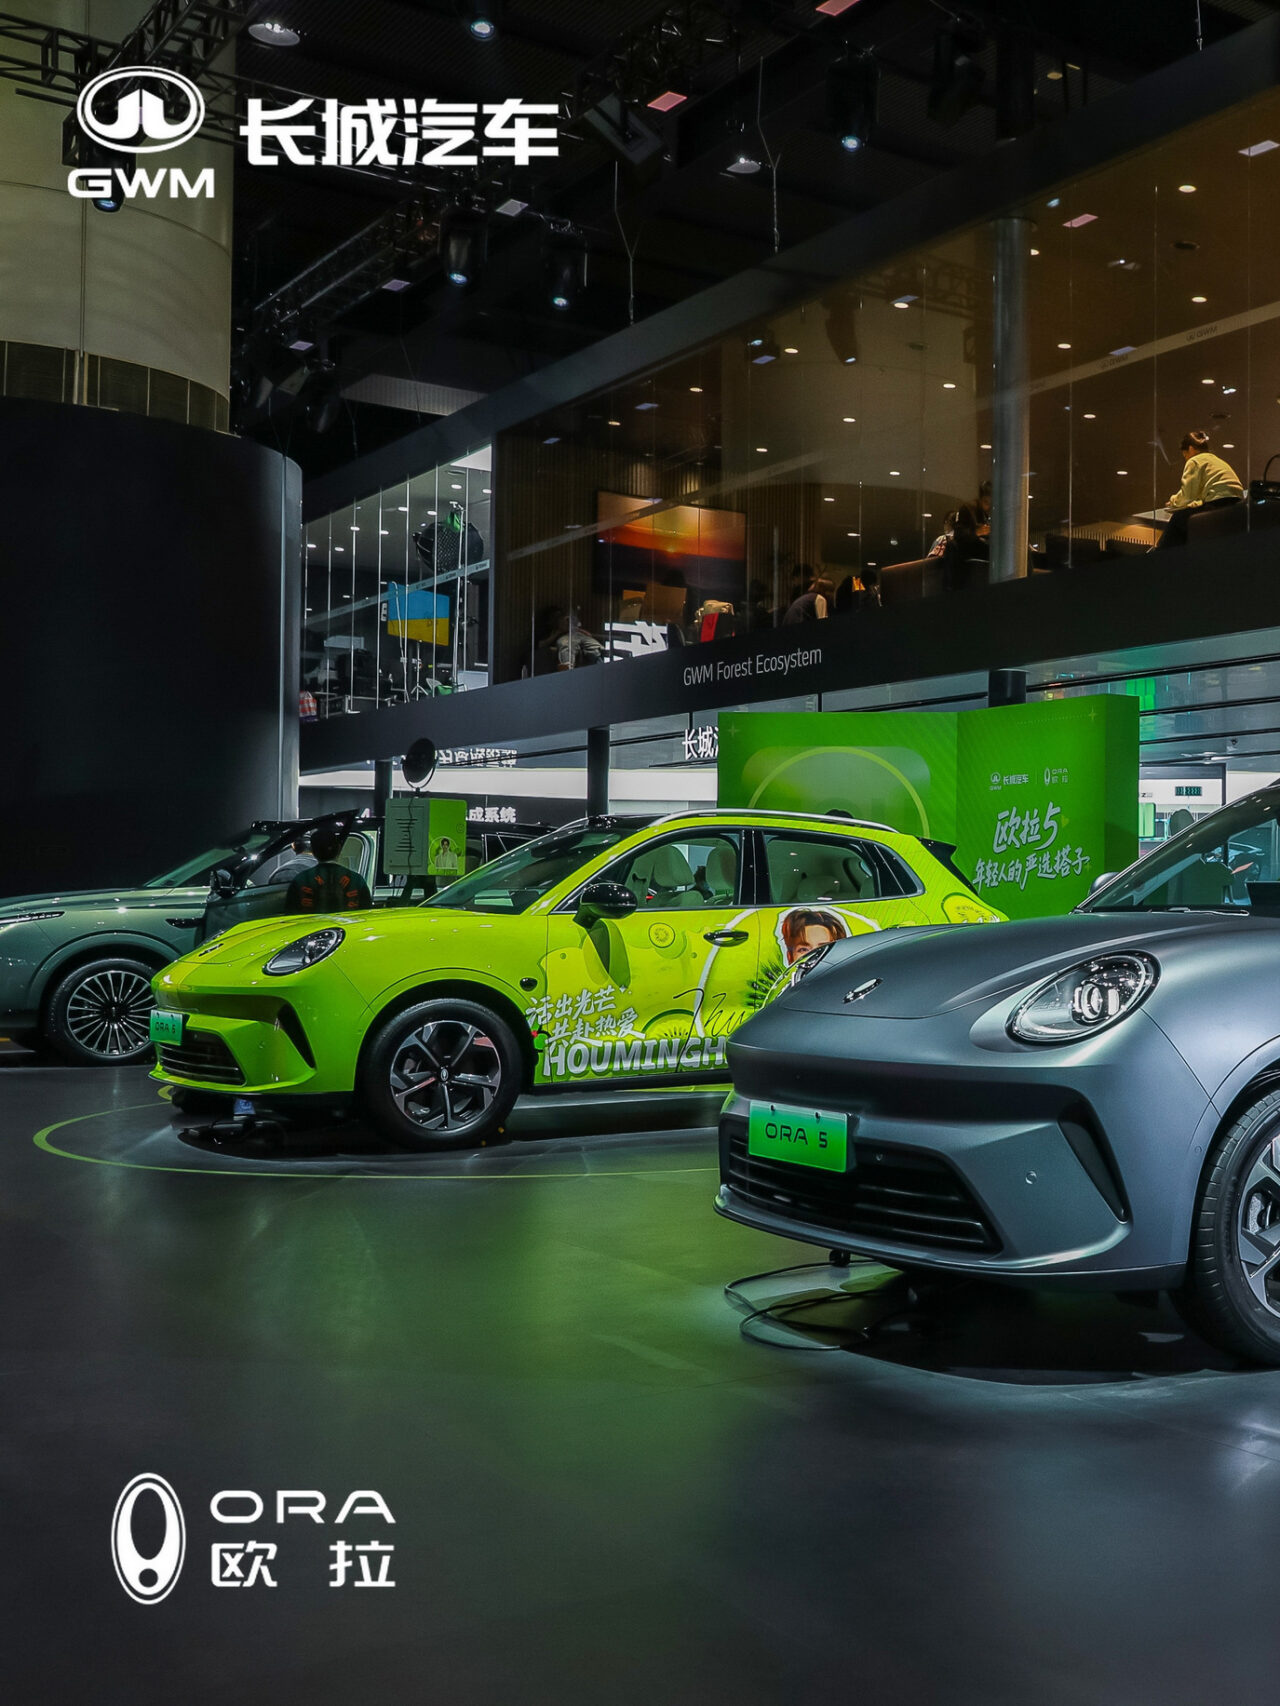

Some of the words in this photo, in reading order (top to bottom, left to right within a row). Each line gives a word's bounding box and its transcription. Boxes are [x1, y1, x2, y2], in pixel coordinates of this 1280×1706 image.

[683, 664, 713, 686] GWM
[717, 657, 753, 681] Forest
[756, 648, 822, 675] Ecosystem
[993, 801, 1061, 853] 欧拉5
[525, 985, 616, 1027] 活出光芒
[545, 1007, 646, 1047] 共赴热爱
[543, 1035, 728, 1077] HOUMINGH
[765, 1123, 808, 1145] ORA
[818, 1131, 829, 1148] 5
